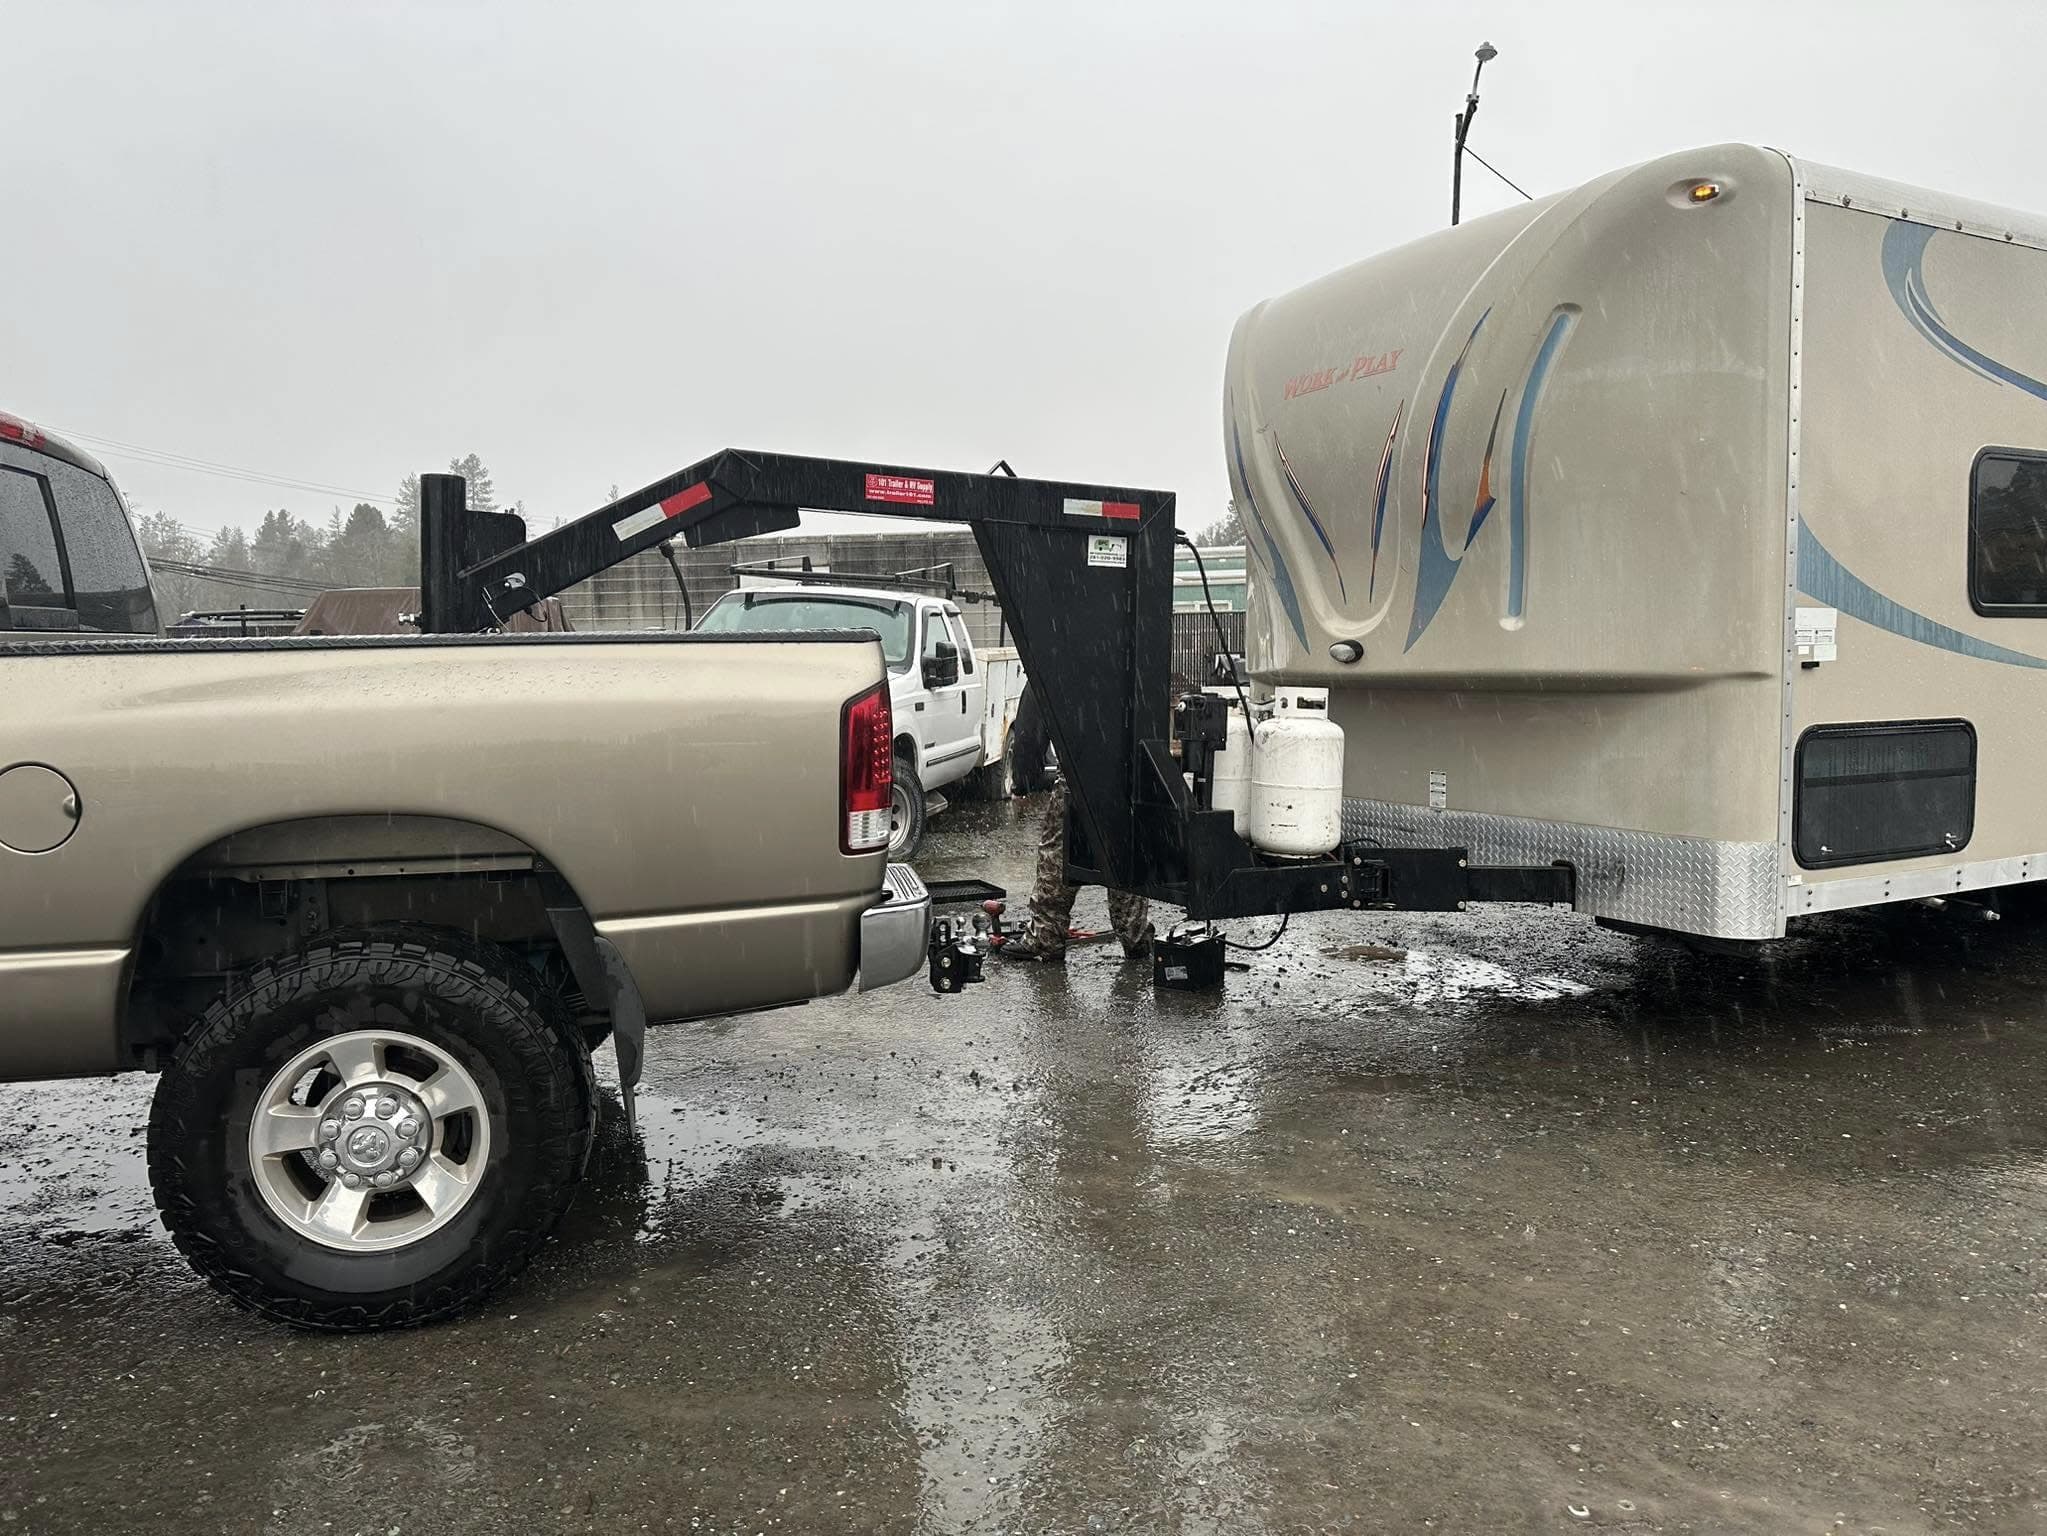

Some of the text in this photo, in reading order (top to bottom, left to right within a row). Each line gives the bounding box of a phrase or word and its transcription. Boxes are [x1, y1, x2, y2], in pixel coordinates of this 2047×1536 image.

[1284, 368, 1337, 400] WORK
[1350, 349, 1404, 381] PLAY
[878, 478, 887, 487] 101
[888, 478, 904, 488] Trailer
[909, 480, 917, 490] RV
[917, 482, 933, 493] Supply
